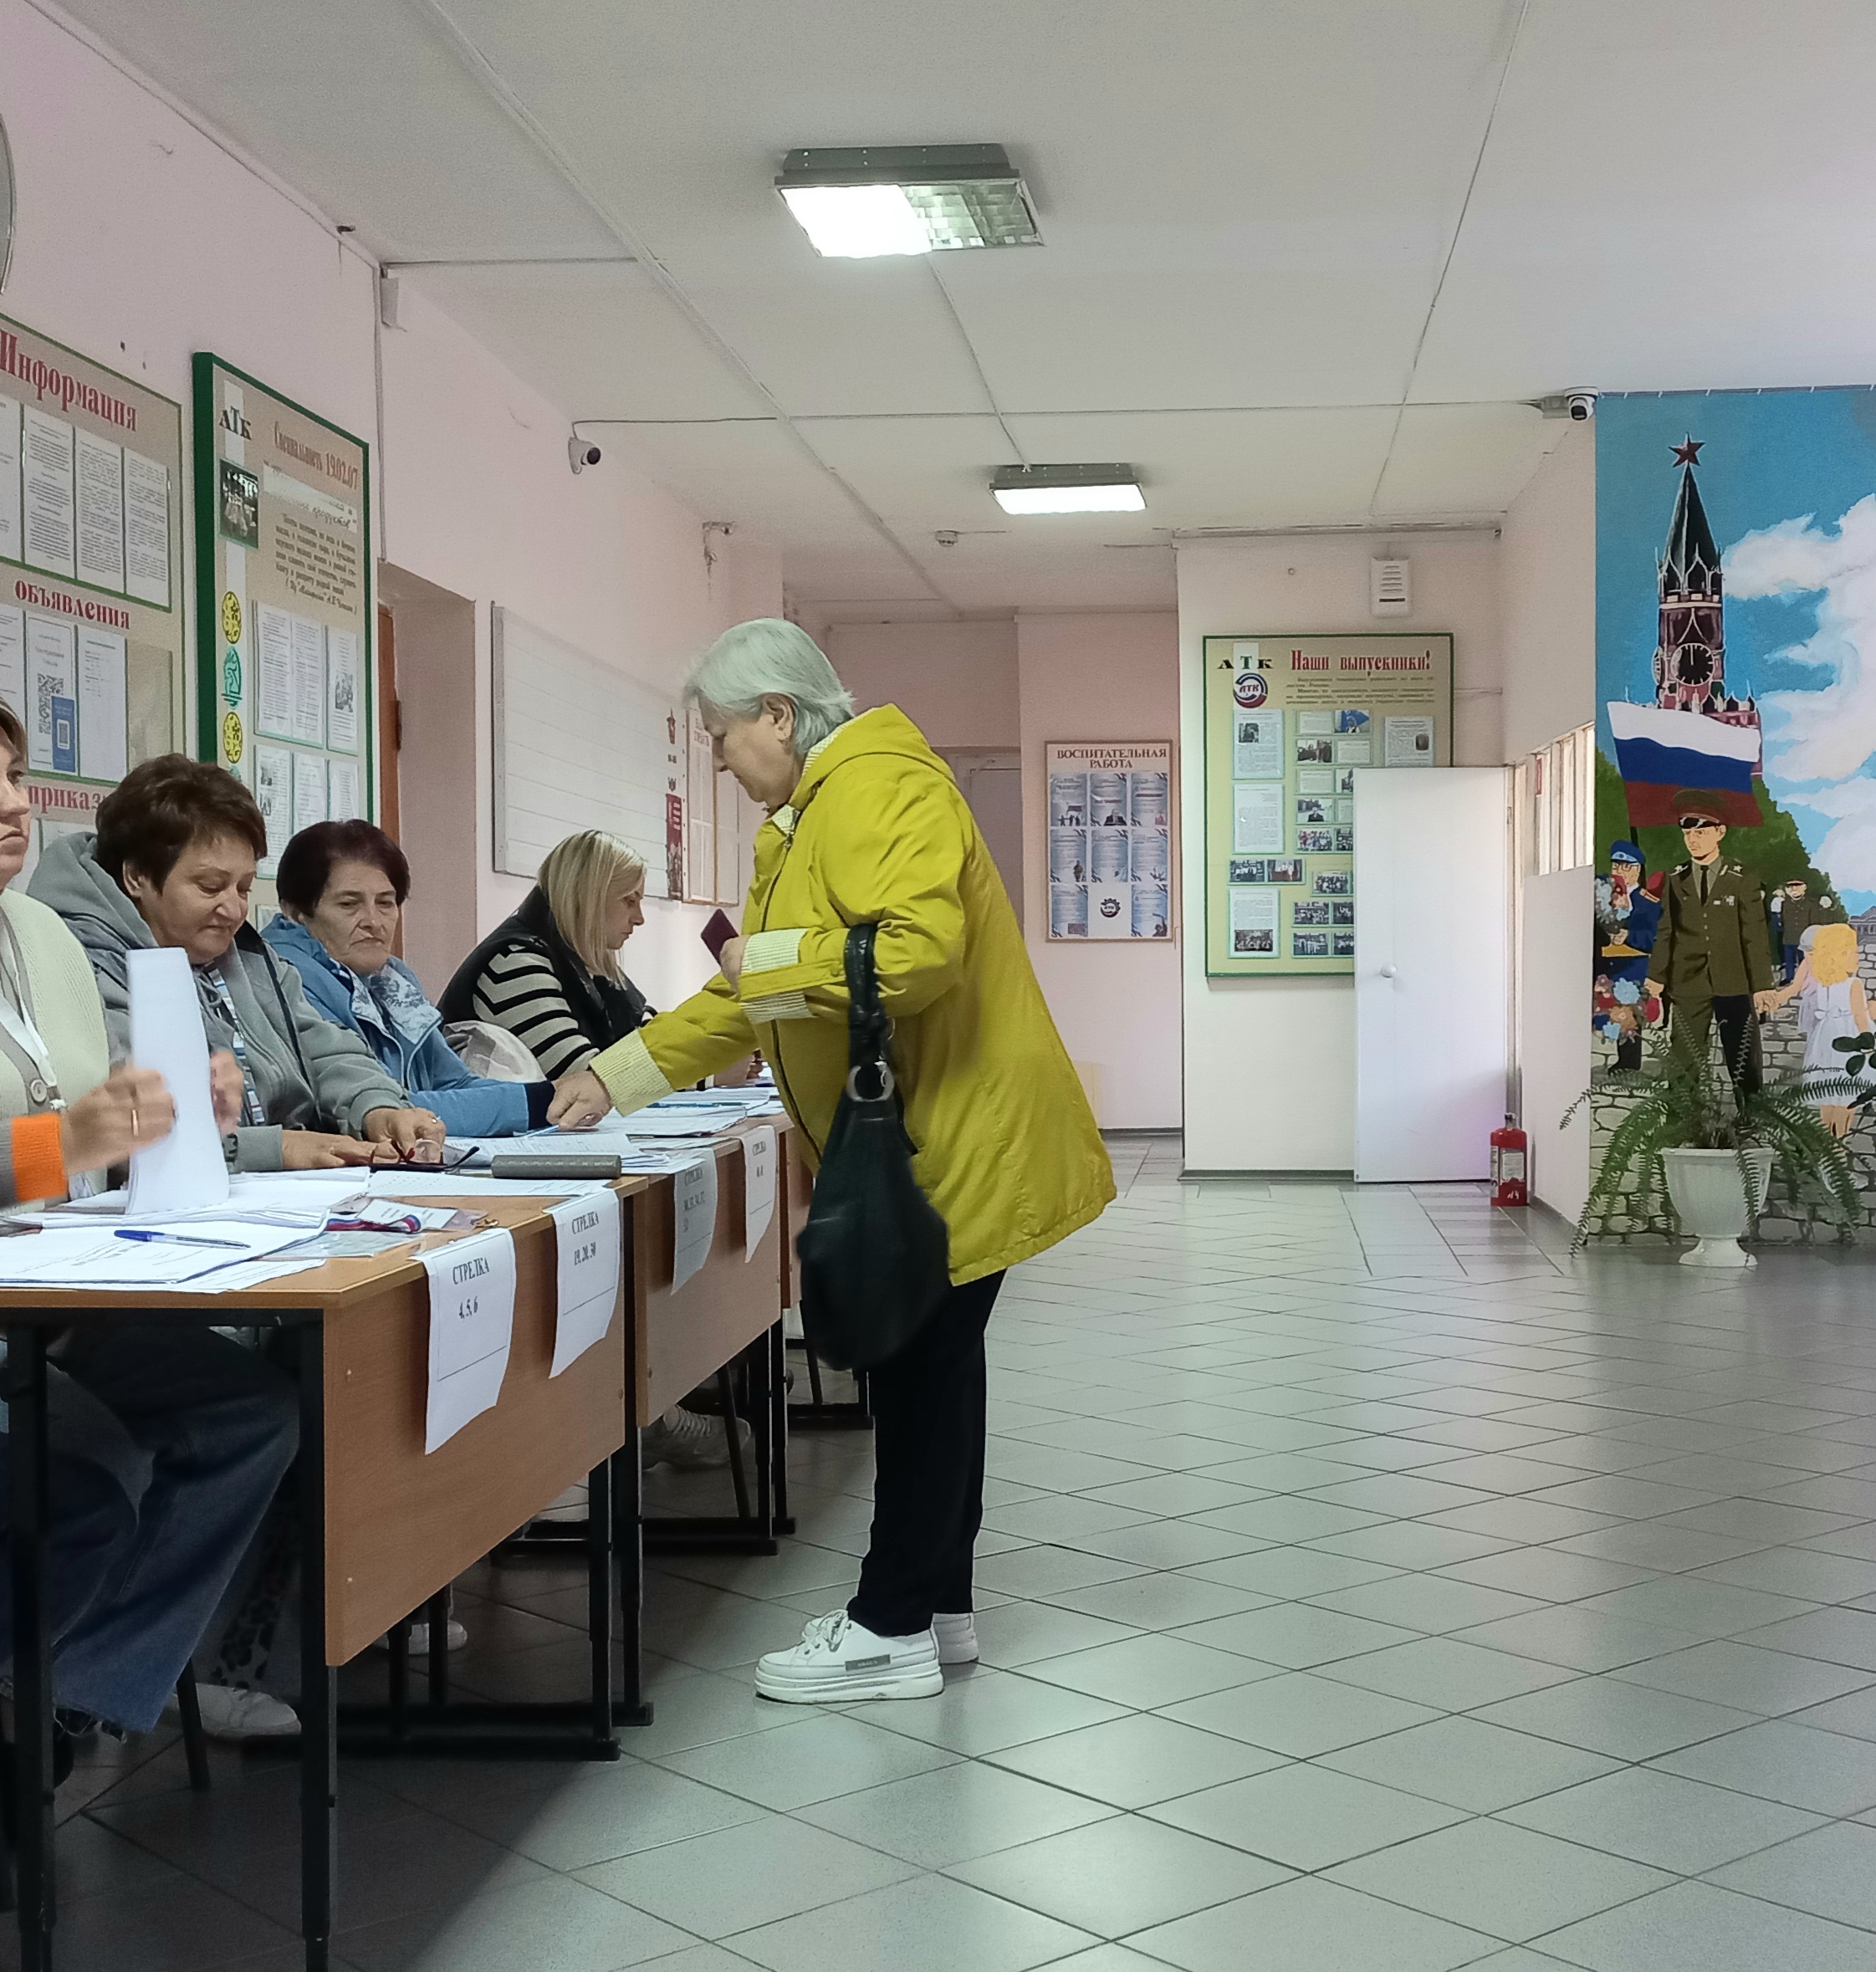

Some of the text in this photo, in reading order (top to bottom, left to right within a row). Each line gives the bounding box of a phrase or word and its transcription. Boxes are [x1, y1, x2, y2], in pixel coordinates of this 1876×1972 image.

[0, 329, 136, 432] Информация
[1291, 649, 1431, 677] Наши выпускники!
[1056, 748, 1168, 759] ВОСПИТАТЕЛЬНАЯ
[1089, 759, 1133, 769] РАБОТА
[28, 785, 107, 814] приказ
[452, 1257, 490, 1285] СТРЕЛКА
